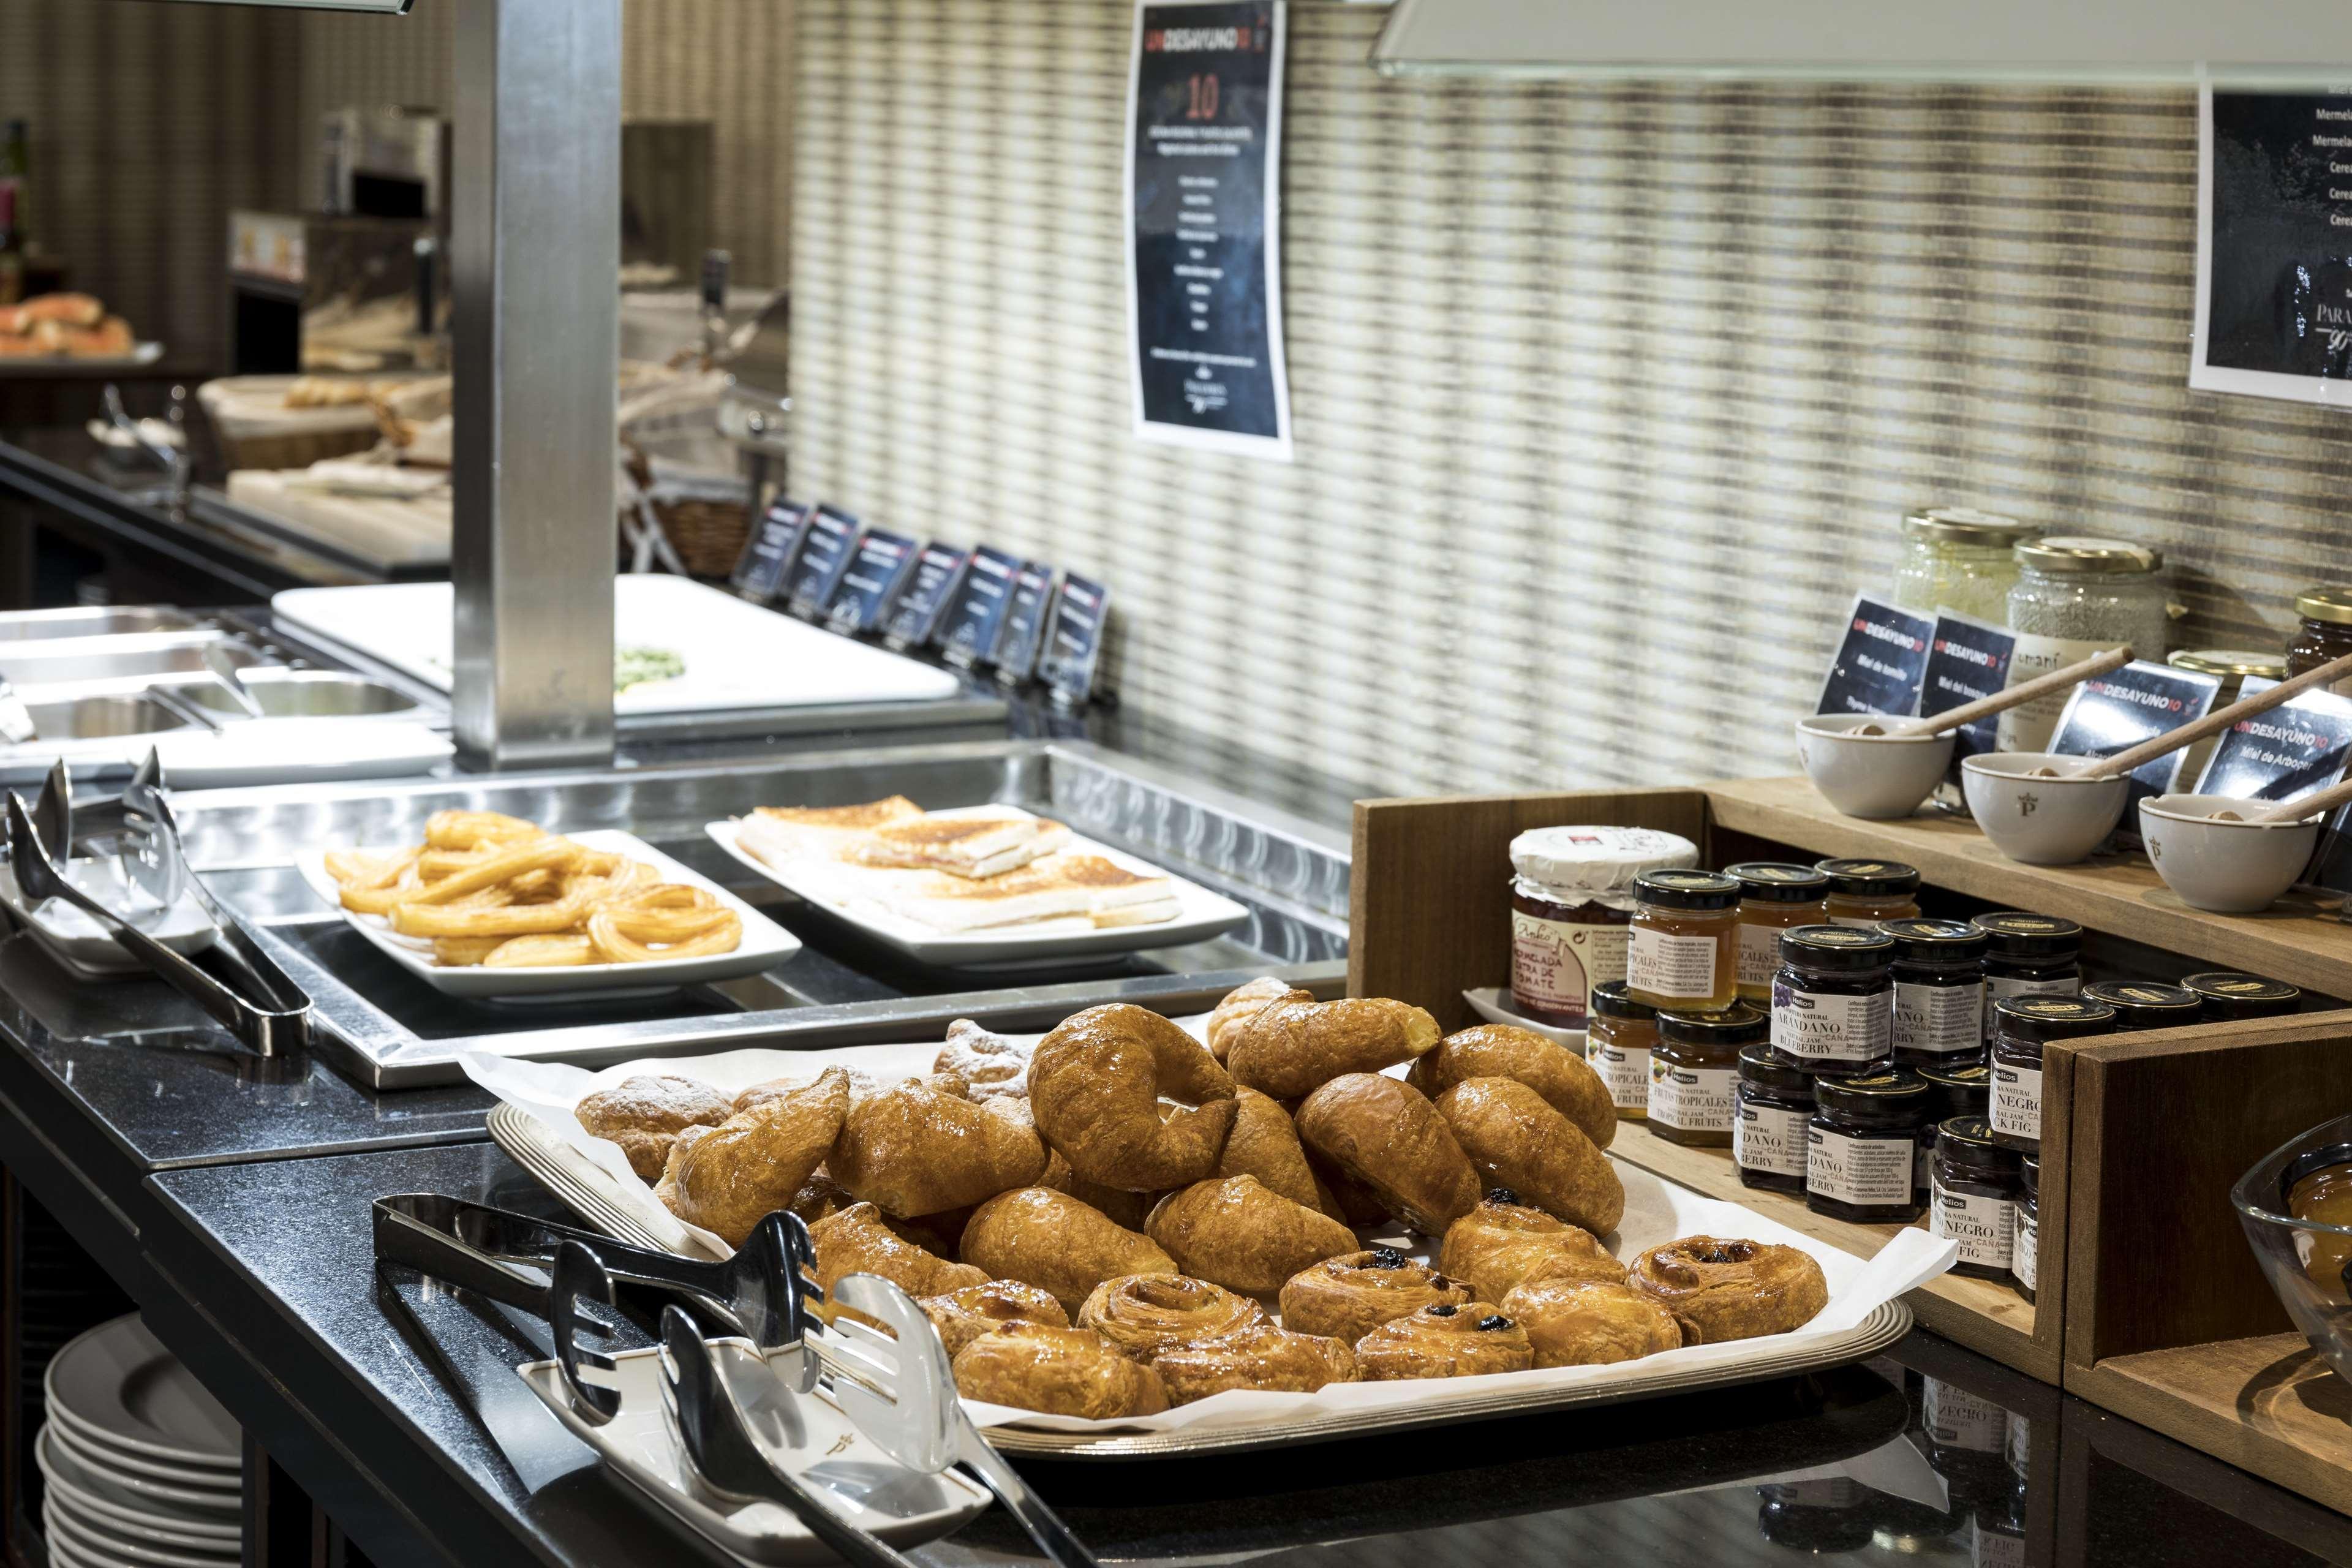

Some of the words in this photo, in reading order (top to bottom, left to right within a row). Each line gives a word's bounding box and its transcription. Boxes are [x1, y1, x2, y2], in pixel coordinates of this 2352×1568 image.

[1186, 74, 1219, 119] 10
[2087, 680, 2182, 711] UNDESAYUNO10
[2234, 721, 2328, 748] UNDESAYUNO10
[2241, 746, 2263, 760] Miel
[2261, 751, 2275, 763] de
[1792, 997, 1813, 1008] Helios
[1803, 1011, 1829, 1021] NATURAL
[1780, 1034, 1833, 1054] BLUEBERRY
[1605, 1072, 1649, 1085] TROPICALE
[1673, 1072, 1696, 1083] Helios
[1655, 1087, 1675, 1102] FRUTAS
[1675, 1093, 1728, 1108] TROPICALES
[2005, 1087, 2032, 1098] NATURAL
[1689, 1117, 1722, 1127] FRUITS
[2010, 1112, 2023, 1120] JAM
[1746, 1125, 1770, 1134] NATURAL
[2011, 1120, 2031, 1133] FIG
[1743, 1132, 1781, 1148] DANO
[1812, 1147, 1833, 1159] NATURAL
[1810, 1155, 1842, 1174] DANO
[1941, 1195, 1964, 1207] Helios
[1953, 1214, 1980, 1224] NATURAL
[1945, 1220, 1994, 1238] NEGRO
[1960, 1247, 1980, 1258] FIG
